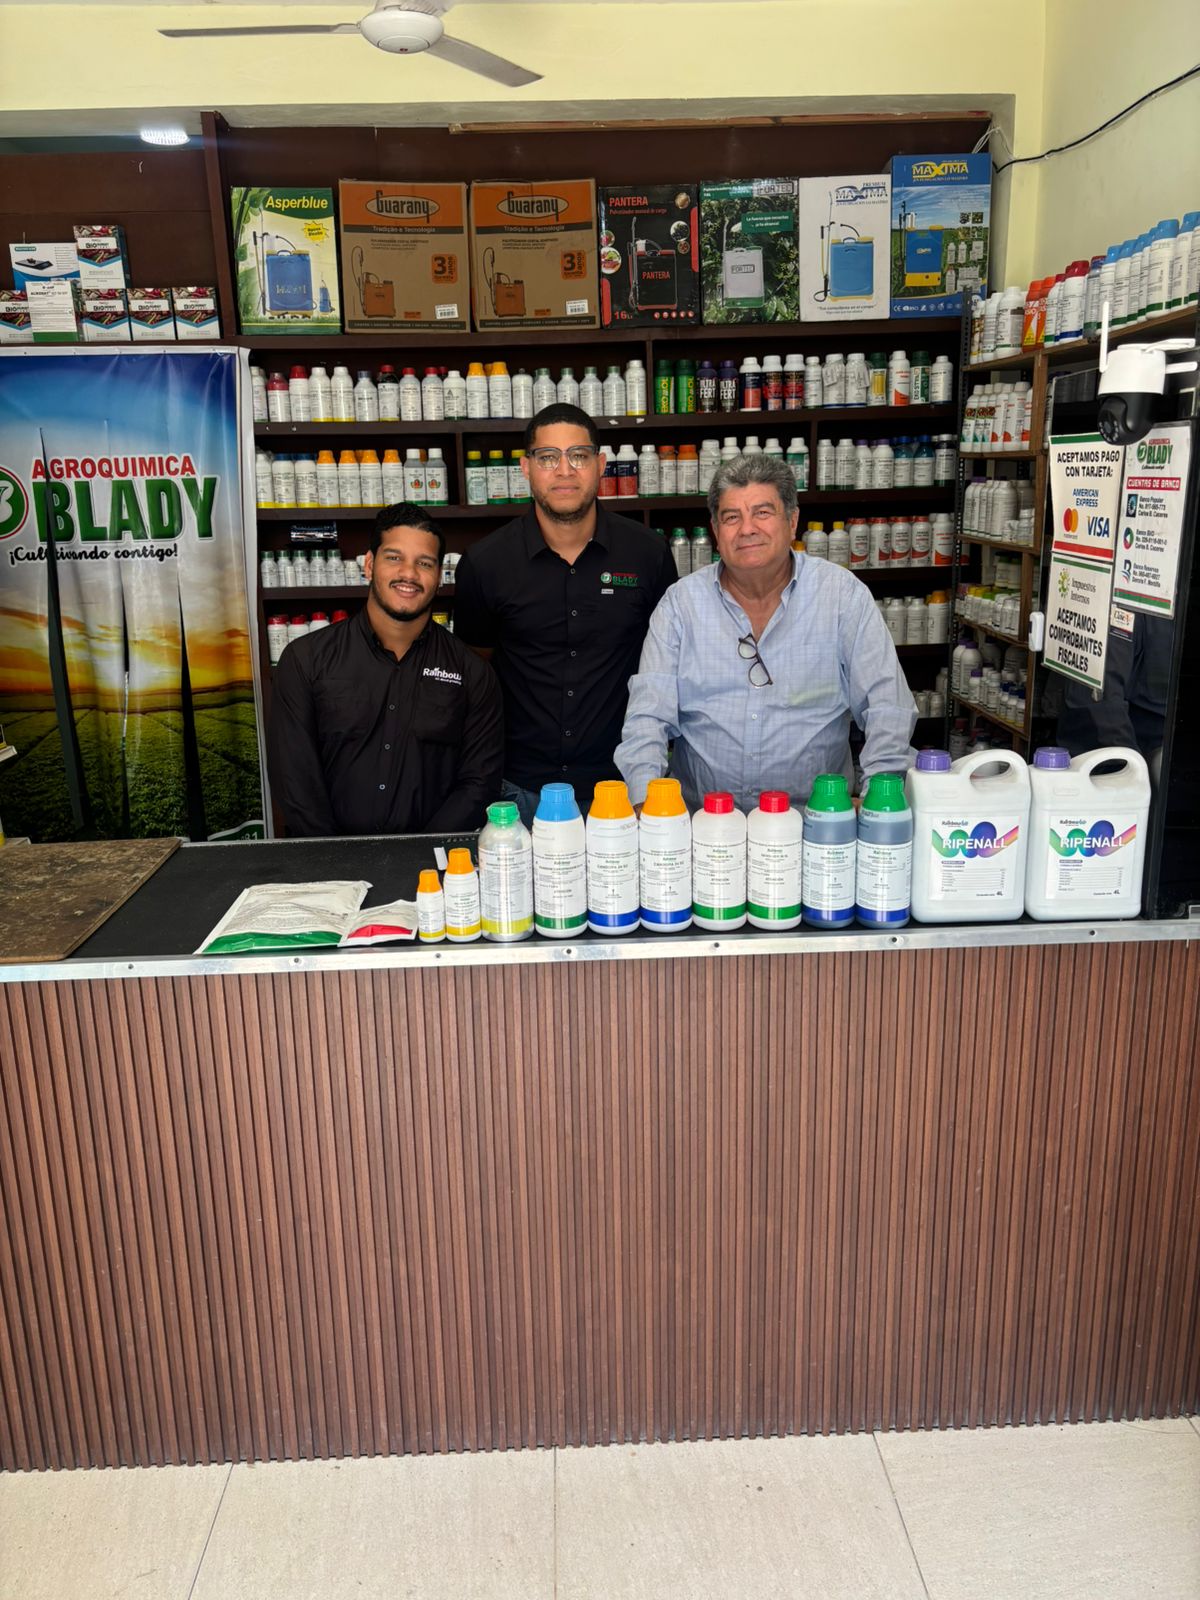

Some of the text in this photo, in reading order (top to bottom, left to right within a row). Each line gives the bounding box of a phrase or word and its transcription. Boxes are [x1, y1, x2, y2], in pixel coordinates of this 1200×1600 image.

[265, 196, 328, 211] Asperblue
[376, 190, 430, 223] Guarany
[508, 191, 558, 221] Guarany
[609, 196, 648, 206] PANTERA
[434, 256, 446, 274] 3
[563, 253, 576, 271] 3
[642, 271, 670, 280] PANTERA
[700, 388, 716, 398] FERT
[720, 389, 736, 399] FERT
[1057, 450, 1120, 463] ACEPTAMOS PAGO
[1146, 445, 1173, 464] BLADY
[32, 456, 196, 479] AGROQUIMICA
[1065, 466, 1113, 477] CON TARJETA:
[1128, 479, 1180, 489] CUENTAS DE BANCO
[1072, 489, 1099, 497] AMERICAN
[1076, 498, 1098, 507] EXPRESS
[32, 477, 218, 543] BLADY
[1087, 515, 1110, 538] VISA
[114, 543, 178, 561] contigo!
[612, 576, 638, 585] BLADY
[1071, 578, 1096, 593] Impuestos
[1070, 591, 1090, 605] Internos
[1057, 607, 1097, 634] ACEPTAMOS
[1049, 624, 1103, 658] COMPROBANTES
[1058, 646, 1089, 673] FISCALES
[423, 667, 462, 681] Rainbow
[942, 838, 1008, 850] RIPENALL
[1060, 837, 1126, 849] RIPENALL
